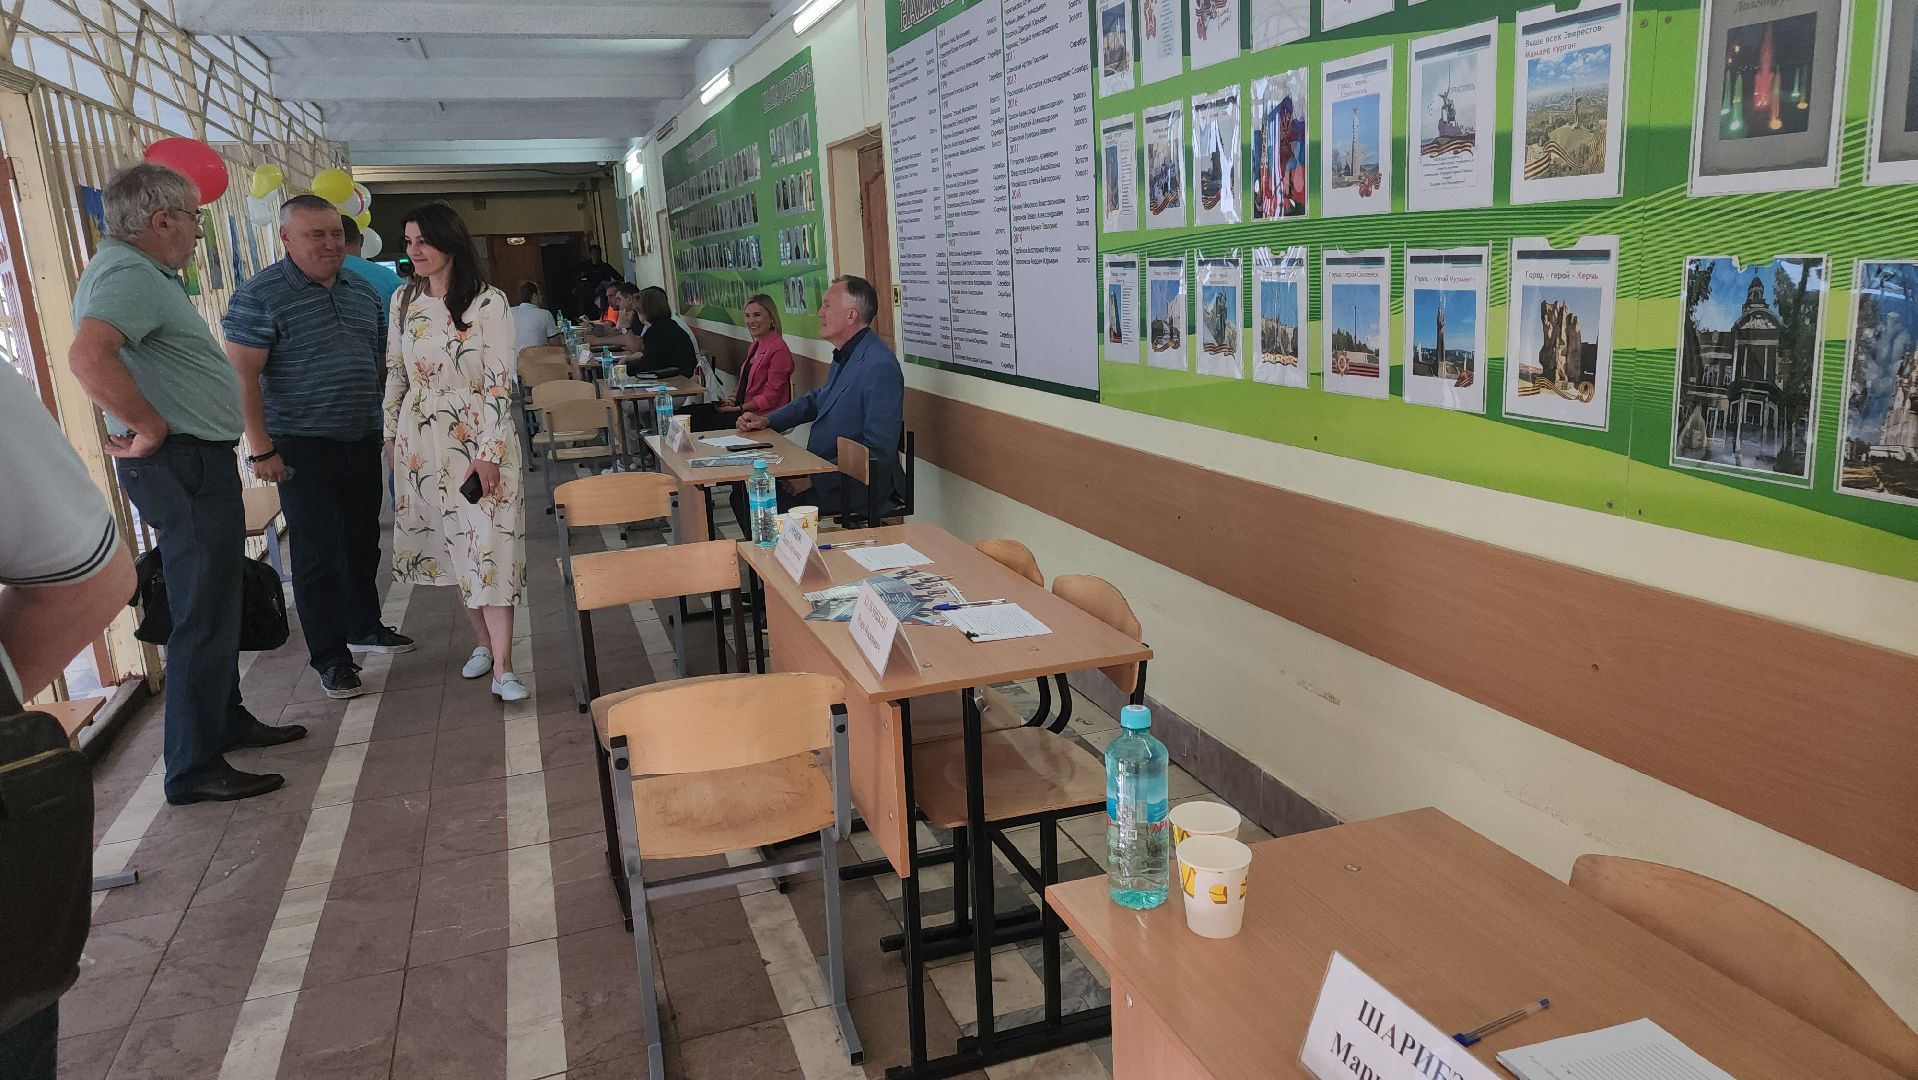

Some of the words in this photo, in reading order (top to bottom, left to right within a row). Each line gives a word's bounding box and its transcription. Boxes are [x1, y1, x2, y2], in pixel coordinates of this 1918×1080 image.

[1525, 38, 1544, 48] Выше
[1552, 42, 1577, 55] курган
[1525, 270, 1545, 280] Город
[1550, 270, 1571, 281] герой
[1576, 271, 1599, 281] Керчь
[1330, 1031, 1383, 1080] Мар
